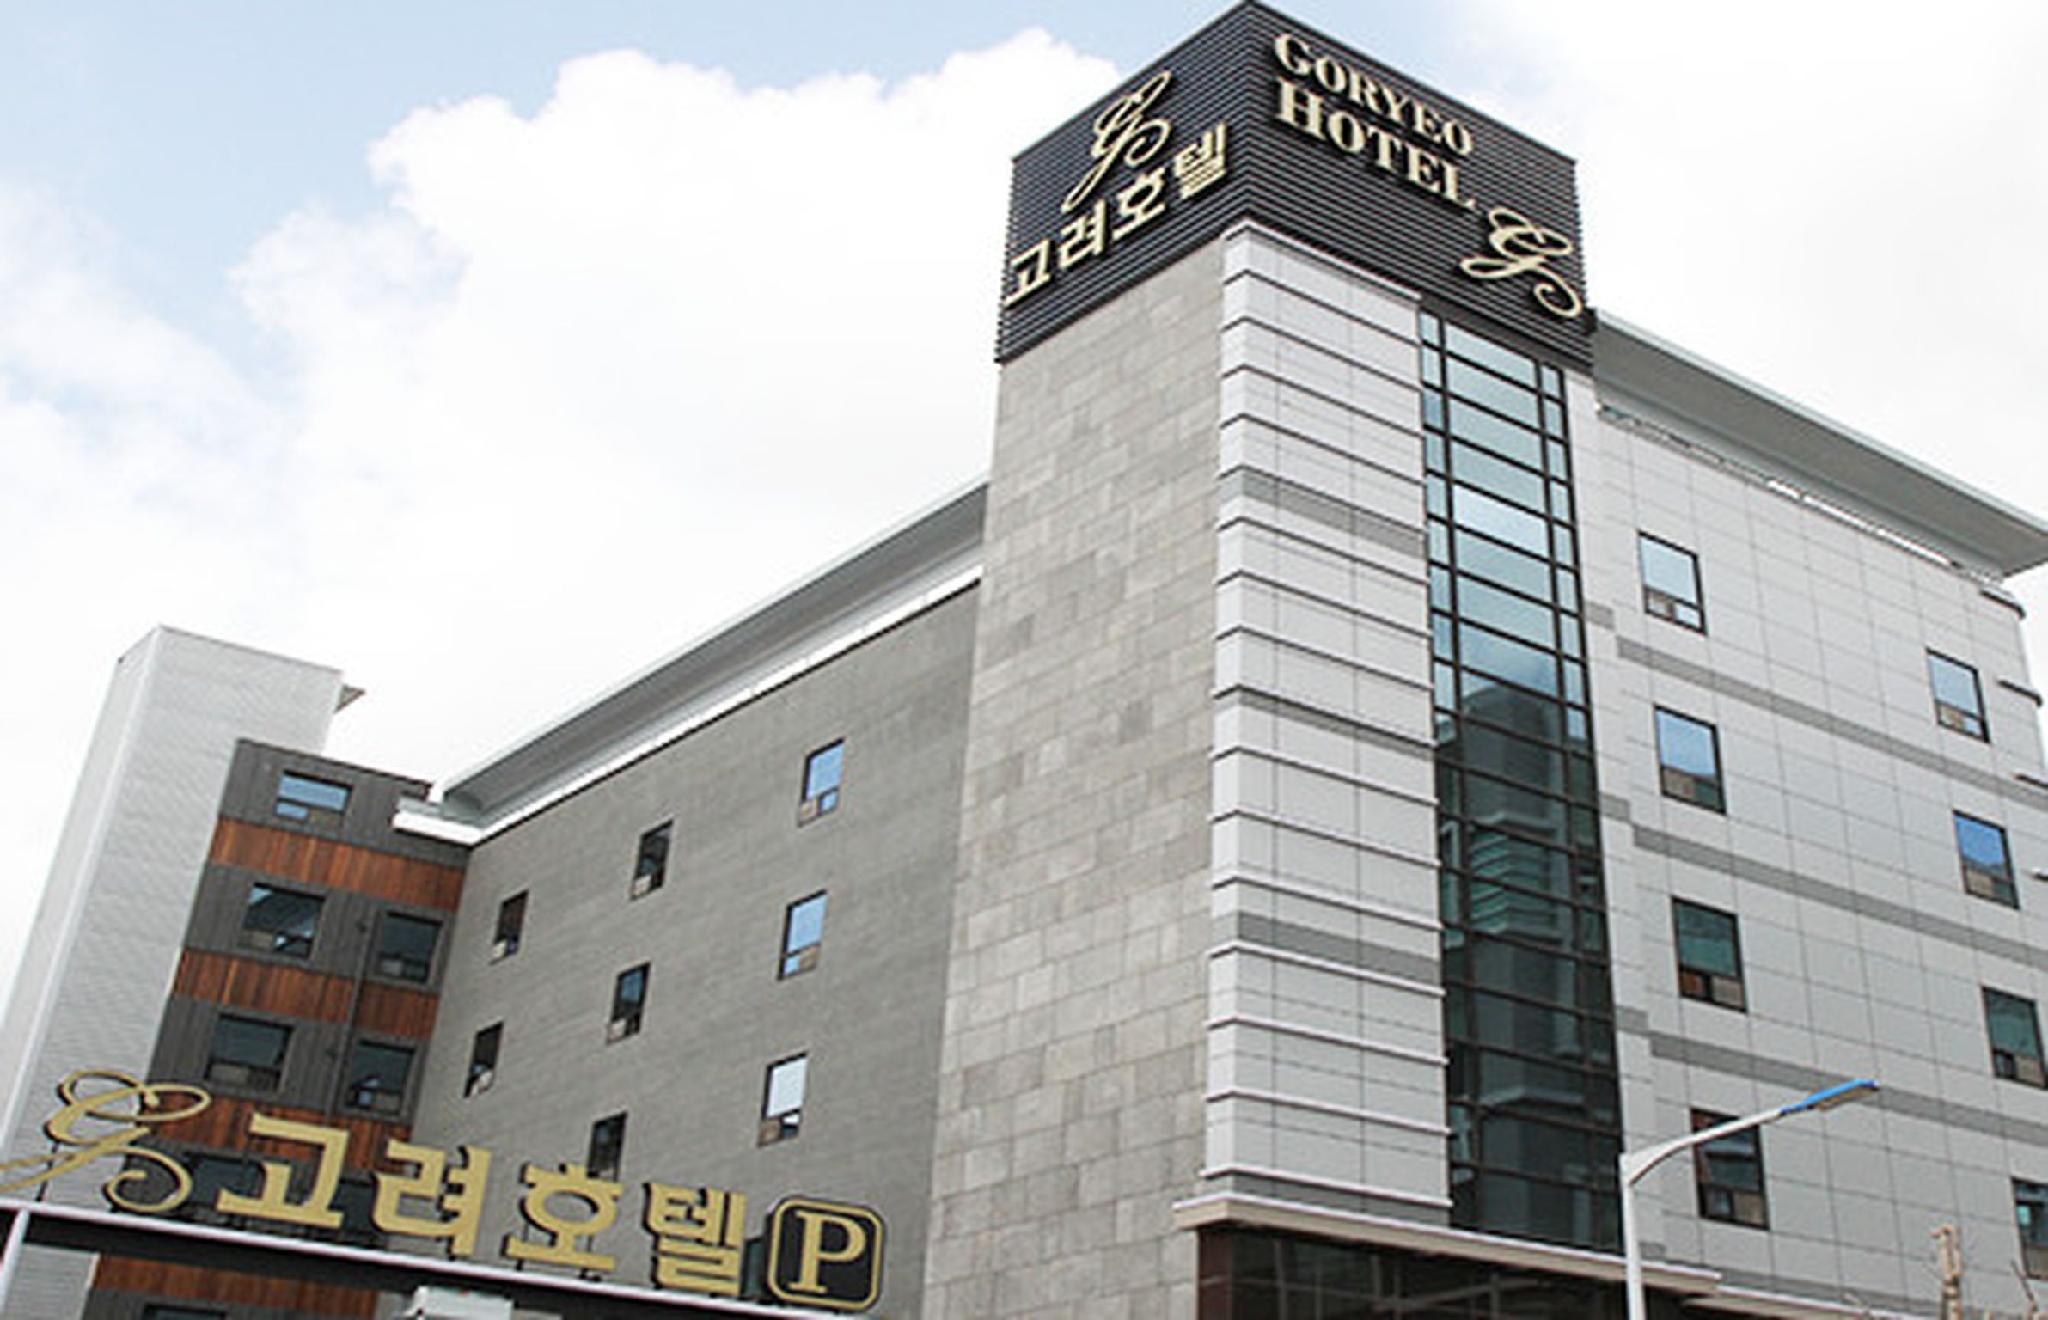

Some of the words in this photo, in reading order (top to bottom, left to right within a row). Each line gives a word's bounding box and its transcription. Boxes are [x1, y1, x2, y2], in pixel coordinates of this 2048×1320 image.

[1274, 33, 1474, 157] GORYEO
[1275, 77, 1477, 210] HOTEL
[1004, 121, 1226, 306] 고려호텔
[216, 1111, 747, 1297] 고려호텔
[786, 1210, 867, 1294] P
